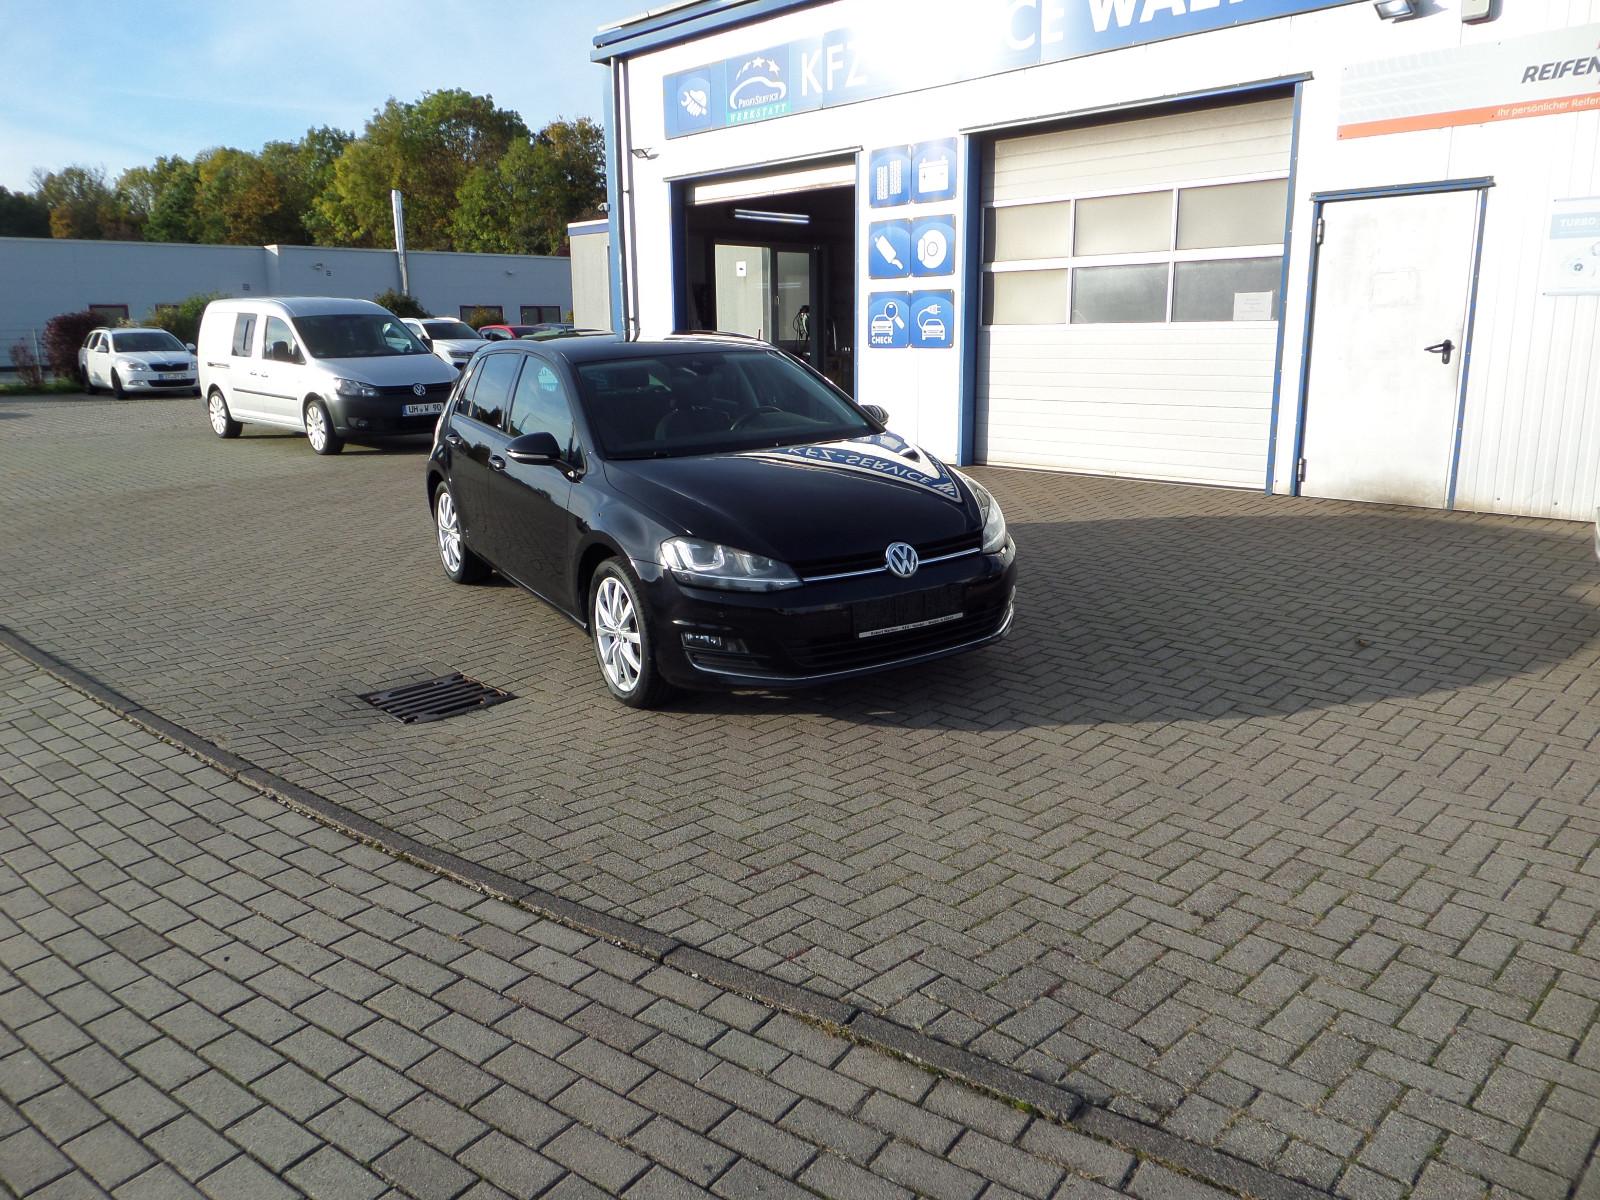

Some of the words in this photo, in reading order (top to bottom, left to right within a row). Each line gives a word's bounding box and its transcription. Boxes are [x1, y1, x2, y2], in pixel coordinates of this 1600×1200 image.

[730, 103, 786, 122] WERKSTATT
[1497, 107, 1509, 117] Ihr
[1511, 101, 1569, 117] persönlicher
[871, 335, 893, 345] CHECK
